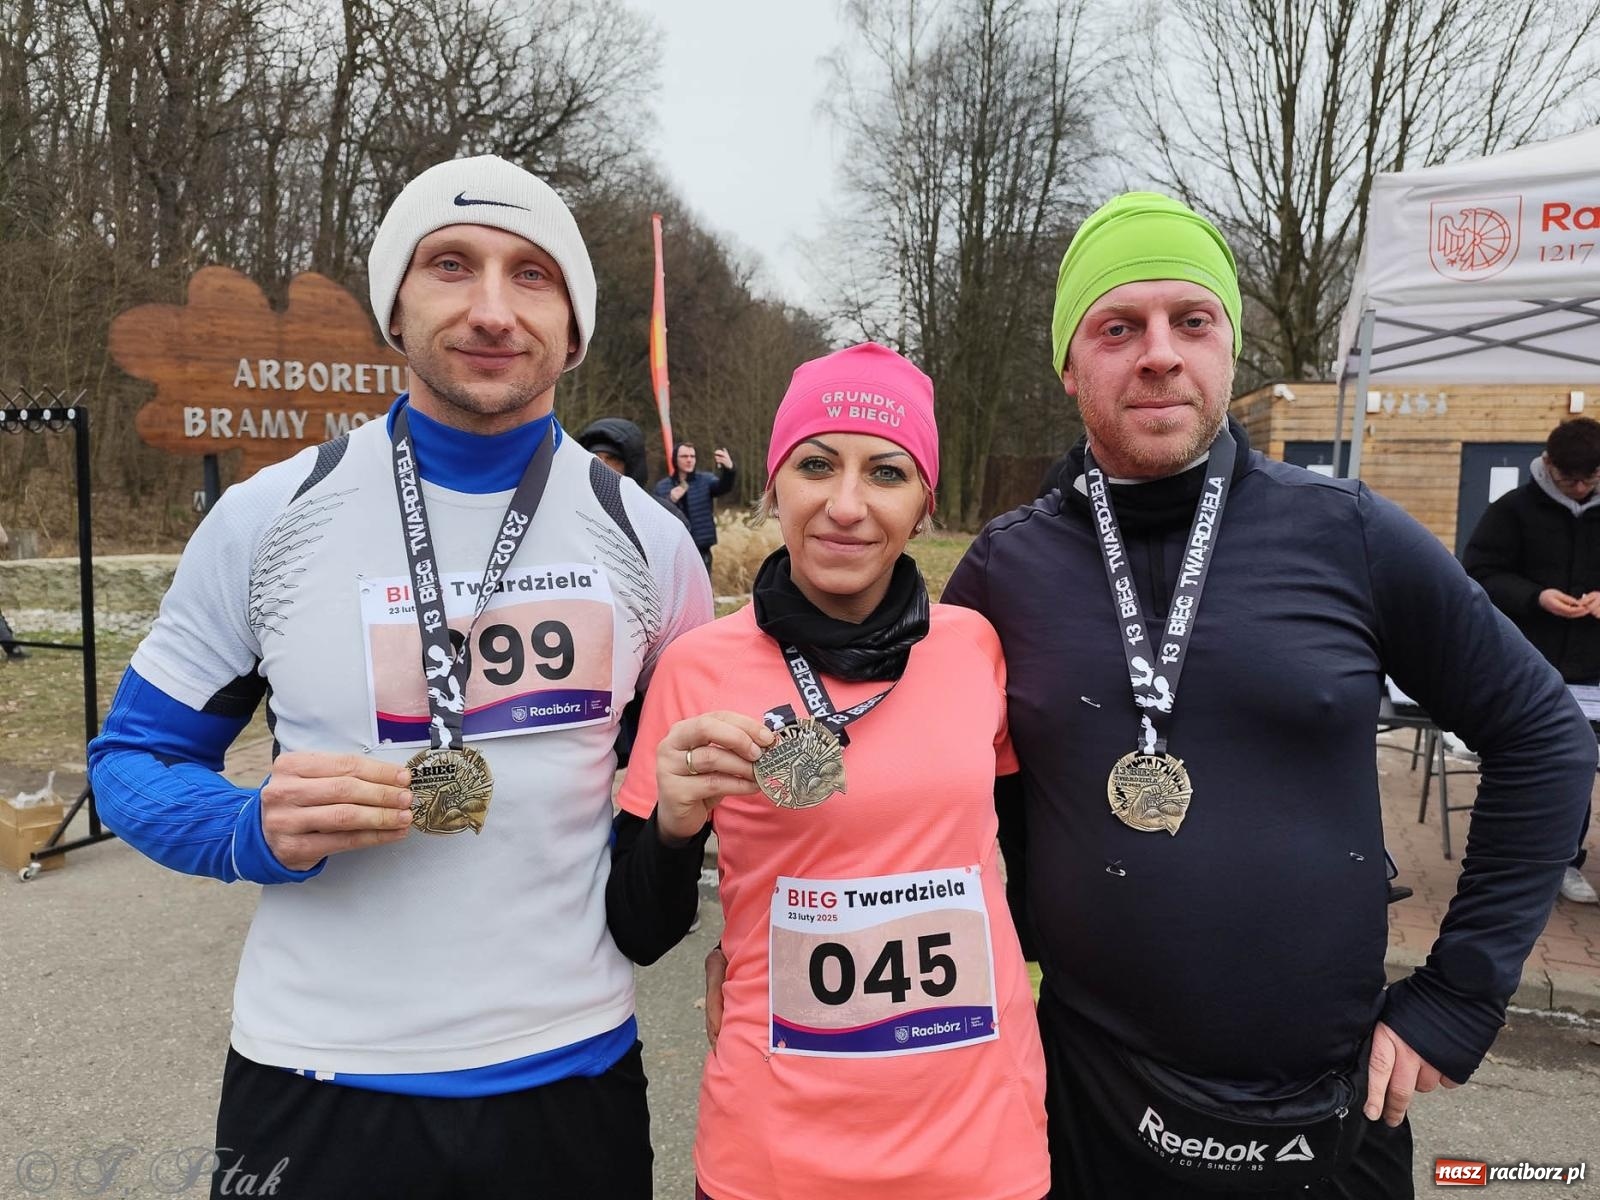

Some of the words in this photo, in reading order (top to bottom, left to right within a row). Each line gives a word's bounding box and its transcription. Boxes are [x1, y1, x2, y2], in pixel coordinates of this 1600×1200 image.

[1542, 202, 1600, 232] Ra
[1539, 244, 1595, 264] 1217
[233, 358, 408, 394] ARBORETU
[821, 391, 906, 416] GRUNDKA
[183, 406, 308, 440] BRAMY
[826, 406, 842, 418] W
[849, 406, 900, 428] BIEGU
[396, 437, 428, 556] TWARDZIELA
[1088, 467, 1125, 574] TWARDZIELA
[1180, 476, 1226, 588] TWARDZIELA
[415, 559, 437, 604] BIEG
[402, 605, 416, 613] lut
[1115, 576, 1138, 619] BIEG
[423, 609, 442, 633] 13
[1168, 595, 1194, 637] BIEG
[1126, 623, 1144, 646] 13
[1161, 642, 1181, 665] 13
[530, 703, 581, 716] Racibórz
[826, 714, 849, 724] 13
[422, 764, 456, 778] BIEG
[788, 889, 838, 909] BIEG
[844, 879, 966, 908] Twardziela
[788, 912, 797, 920] 23
[798, 912, 815, 923] luty
[816, 913, 838, 922] 2025
[808, 931, 958, 1006] 045
[911, 1021, 961, 1038] Racibórz
[1138, 1106, 1270, 1163] Reebok
[1179, 1158, 1193, 1167] CO
